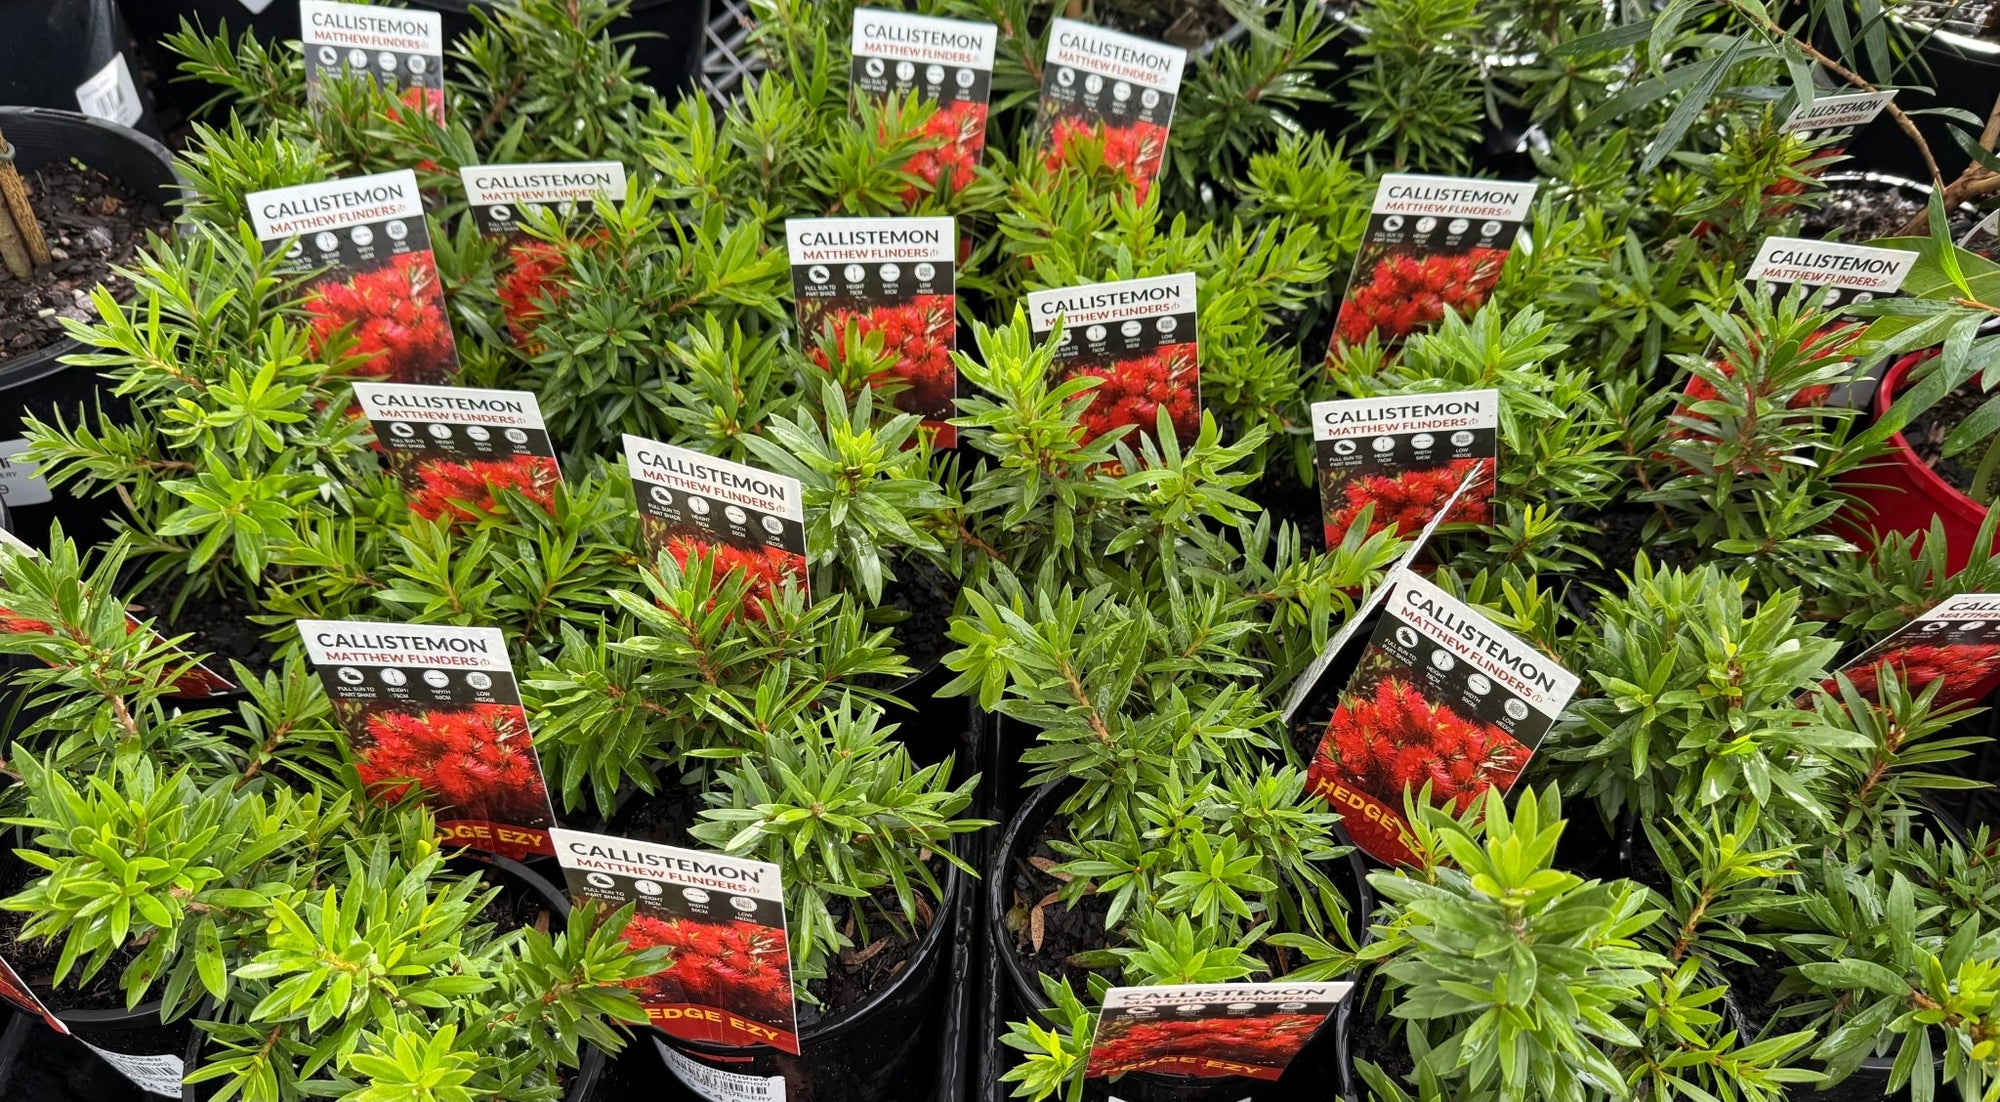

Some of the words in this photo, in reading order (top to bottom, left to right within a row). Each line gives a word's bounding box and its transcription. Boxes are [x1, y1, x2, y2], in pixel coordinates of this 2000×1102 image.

[312, 12, 428, 36] CALLISTEMON
[315, 30, 371, 44] MATTHEW
[372, 35, 420, 49] FLINDERS
[864, 23, 983, 51] CALLISTEMON
[865, 42, 921, 57] MATTHEW
[922, 48, 971, 63] FLINDERS
[1060, 33, 1171, 72] CALLISTEMON
[1058, 50, 1110, 71] MATTHEW
[1111, 65, 1158, 84] FLINDERS
[1795, 99, 1883, 120] CLLISTEMON
[476, 173, 611, 190] CALLISTEMON
[263, 184, 404, 220] CALLISTEMON
[481, 191, 545, 201] MATTHEW
[1388, 186, 1520, 205] CALLISTEMON
[1385, 201, 1449, 212] MATTHEW
[1448, 205, 1502, 216] FLINDERS
[270, 214, 336, 235] MATTHEW
[339, 204, 396, 223] FLINDERS
[799, 229, 939, 246] CALLISTEMON
[803, 249, 868, 260] MATTHEW
[871, 248, 929, 259] FLINDERS
[1769, 250, 1900, 275] CALLISTEMON
[1762, 268, 1825, 281] MATTHEW
[1041, 285, 1180, 314] CALLISTEMON
[1045, 310, 1110, 327] MTTHEW
[1112, 303, 1169, 318] FLINDERS
[371, 393, 524, 413] CALLISTEMON
[1325, 401, 1480, 425] CALLISTEMON
[379, 409, 450, 420] MATTHEW
[453, 413, 516, 424] FLINDERS
[1328, 423, 1400, 437] MATTHEW
[1402, 418, 1467, 430] FLINDERS
[637, 450, 785, 500] CALLISTEMON
[643, 468, 711, 494] MATTHEW
[714, 487, 775, 511] FLINDERS
[317, 632, 488, 653] CALLISTEMON
[1384, 638, 1398, 650] FULL
[1397, 646, 1409, 657] SUN
[1408, 652, 1417, 661] TO
[1406, 589, 1556, 693] CALLISTEMON
[326, 651, 404, 663] MATTHEW
[408, 654, 479, 666] FLINDERS
[1382, 644, 1396, 655] PART
[1395, 651, 1413, 667] SHADE
[1401, 606, 1470, 655] MATTHEW
[1470, 651, 1533, 698] FLINDERS
[1426, 665, 1446, 680] HEIGHT
[1463, 689, 1480, 703] WIDTH
[1495, 719, 1515, 735] HEDGE
[1502, 716, 1516, 727] LOW
[1318, 776, 1396, 832] HEDGE
[497, 828, 543, 847] EZY
[569, 842, 760, 884] CALLISTEMON
[576, 858, 665, 878] MATTHEW
[669, 872, 747, 892] FLINDERS
[603, 894, 626, 902] SHADE
[639, 894, 663, 902] HEIGHT
[688, 902, 710, 910] WIDTH
[1123, 988, 1326, 1001] CALLISTEMON
[647, 1008, 722, 1023] EDGE
[729, 1017, 779, 1040] EZY
[1206, 1060, 1262, 1074] EZY
